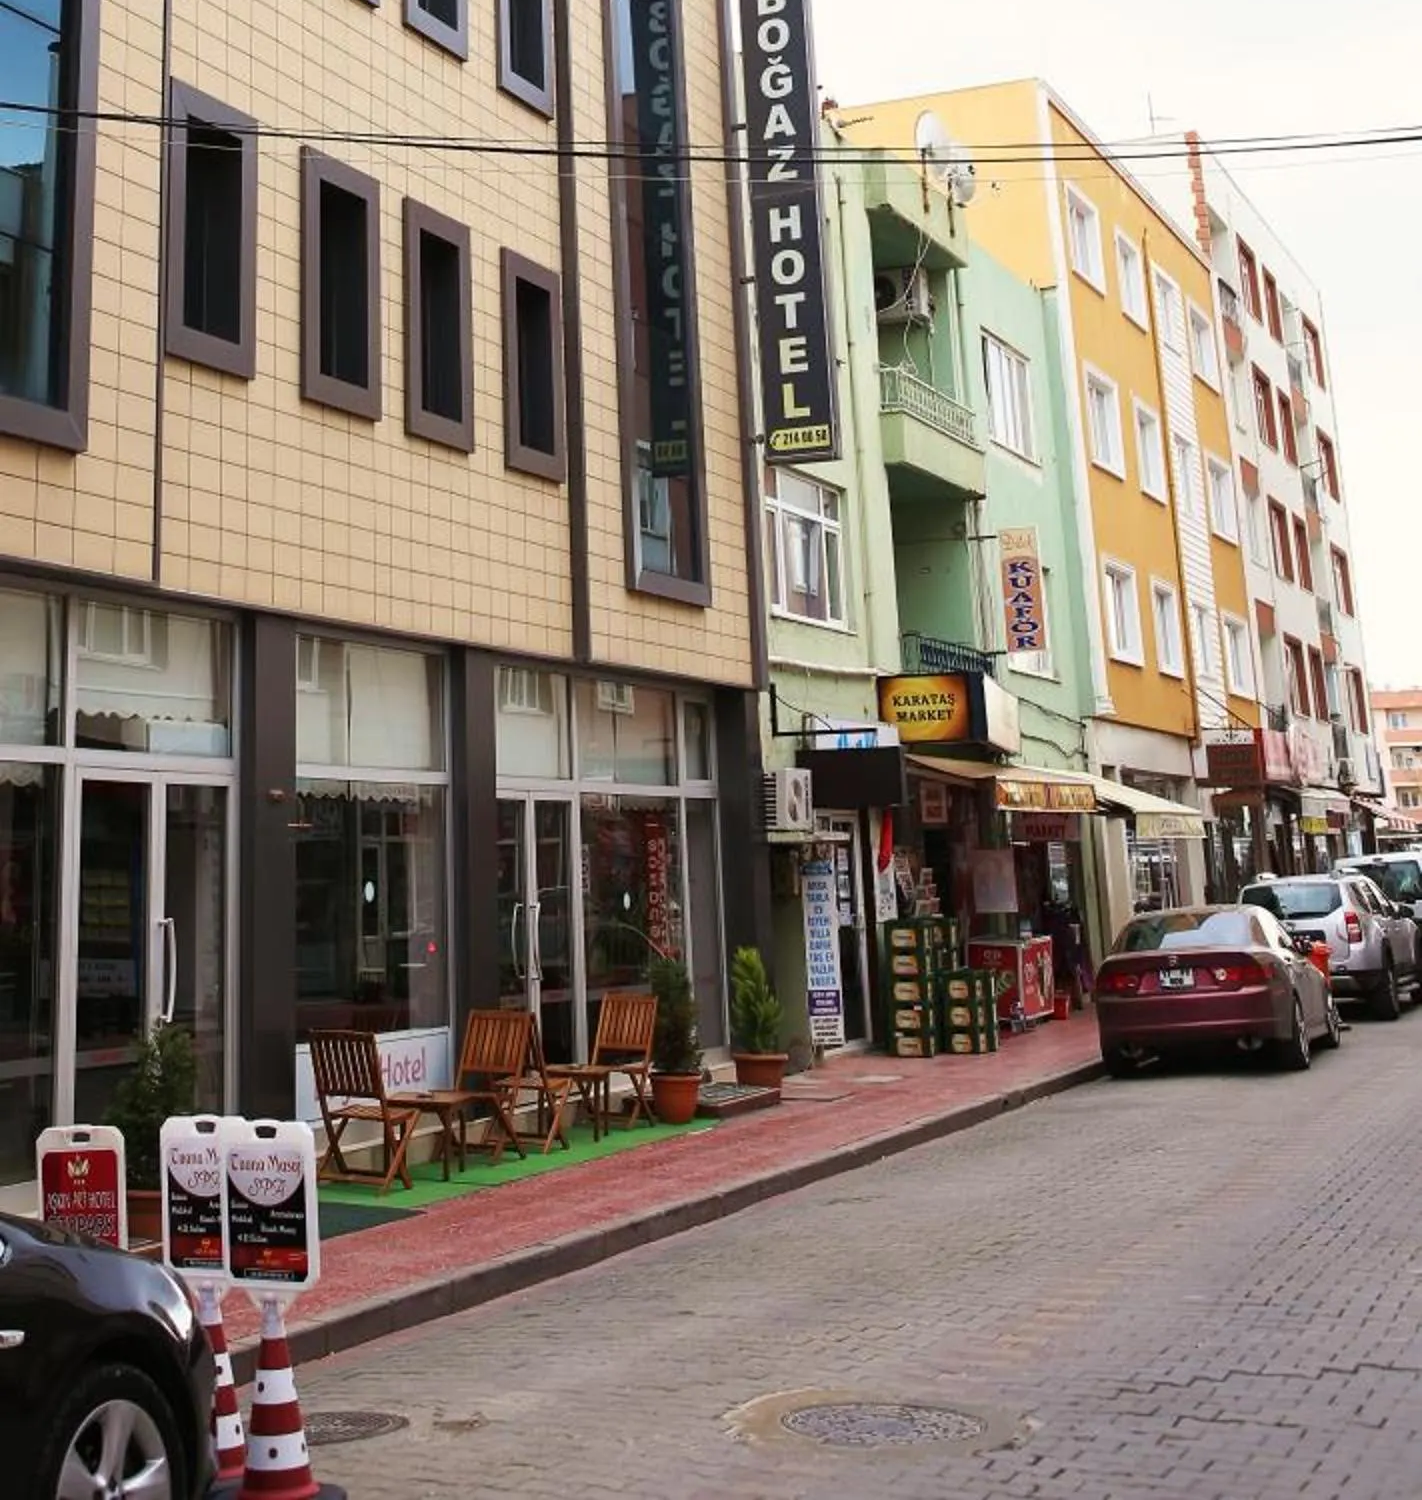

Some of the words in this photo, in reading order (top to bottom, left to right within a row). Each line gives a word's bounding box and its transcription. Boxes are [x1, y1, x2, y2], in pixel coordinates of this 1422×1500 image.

[768, 204, 812, 420] HOTEL
[892, 693, 955, 707] KARATAŞ
[896, 709, 954, 722] MARKET
[380, 1047, 427, 1088] Hotel
